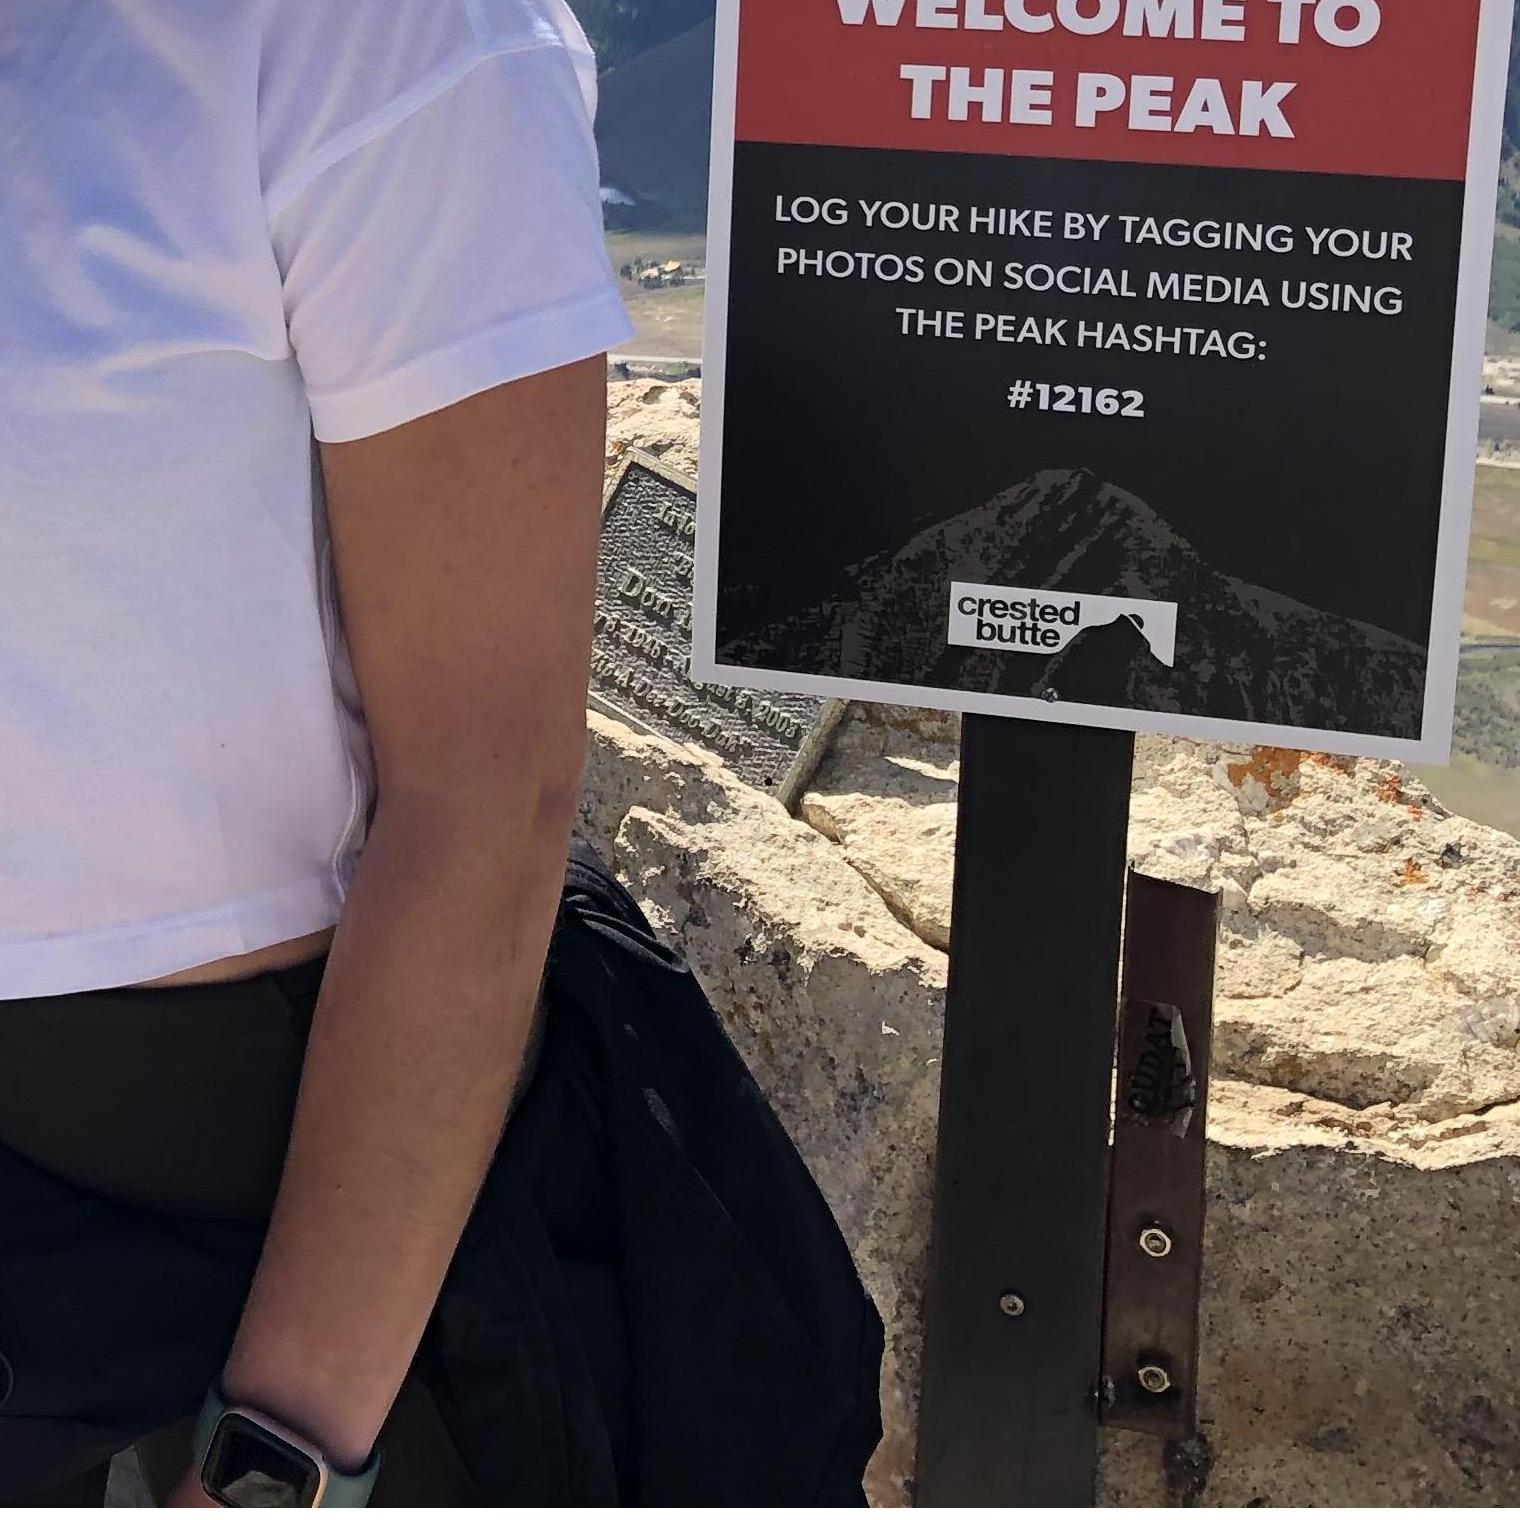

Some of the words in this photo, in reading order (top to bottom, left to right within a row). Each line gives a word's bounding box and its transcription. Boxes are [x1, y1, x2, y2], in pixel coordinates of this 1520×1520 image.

[900, 64, 1054, 125] THE
[1075, 72, 1297, 139] PEAK
[775, 195, 849, 226] LOG
[858, 199, 960, 232] YOUR
[969, 206, 1053, 238] HIKE
[1063, 212, 1111, 241] BY
[1119, 215, 1295, 253] TAGGING
[1305, 226, 1414, 261] YOUR
[777, 247, 926, 283] PHOTOS
[934, 257, 993, 288] ON
[1003, 262, 1137, 298] SOCIAL
[1146, 271, 1270, 307] MEDIA
[1281, 280, 1404, 316] USING
[895, 307, 966, 339] THE
[975, 313, 1068, 347] PEAK
[1077, 321, 1268, 362] HASHTAG:
[1007, 379, 1145, 418] #12162
[619, 566, 672, 616] Don
[957, 596, 1081, 626] crested
[976, 618, 1061, 648] butte
